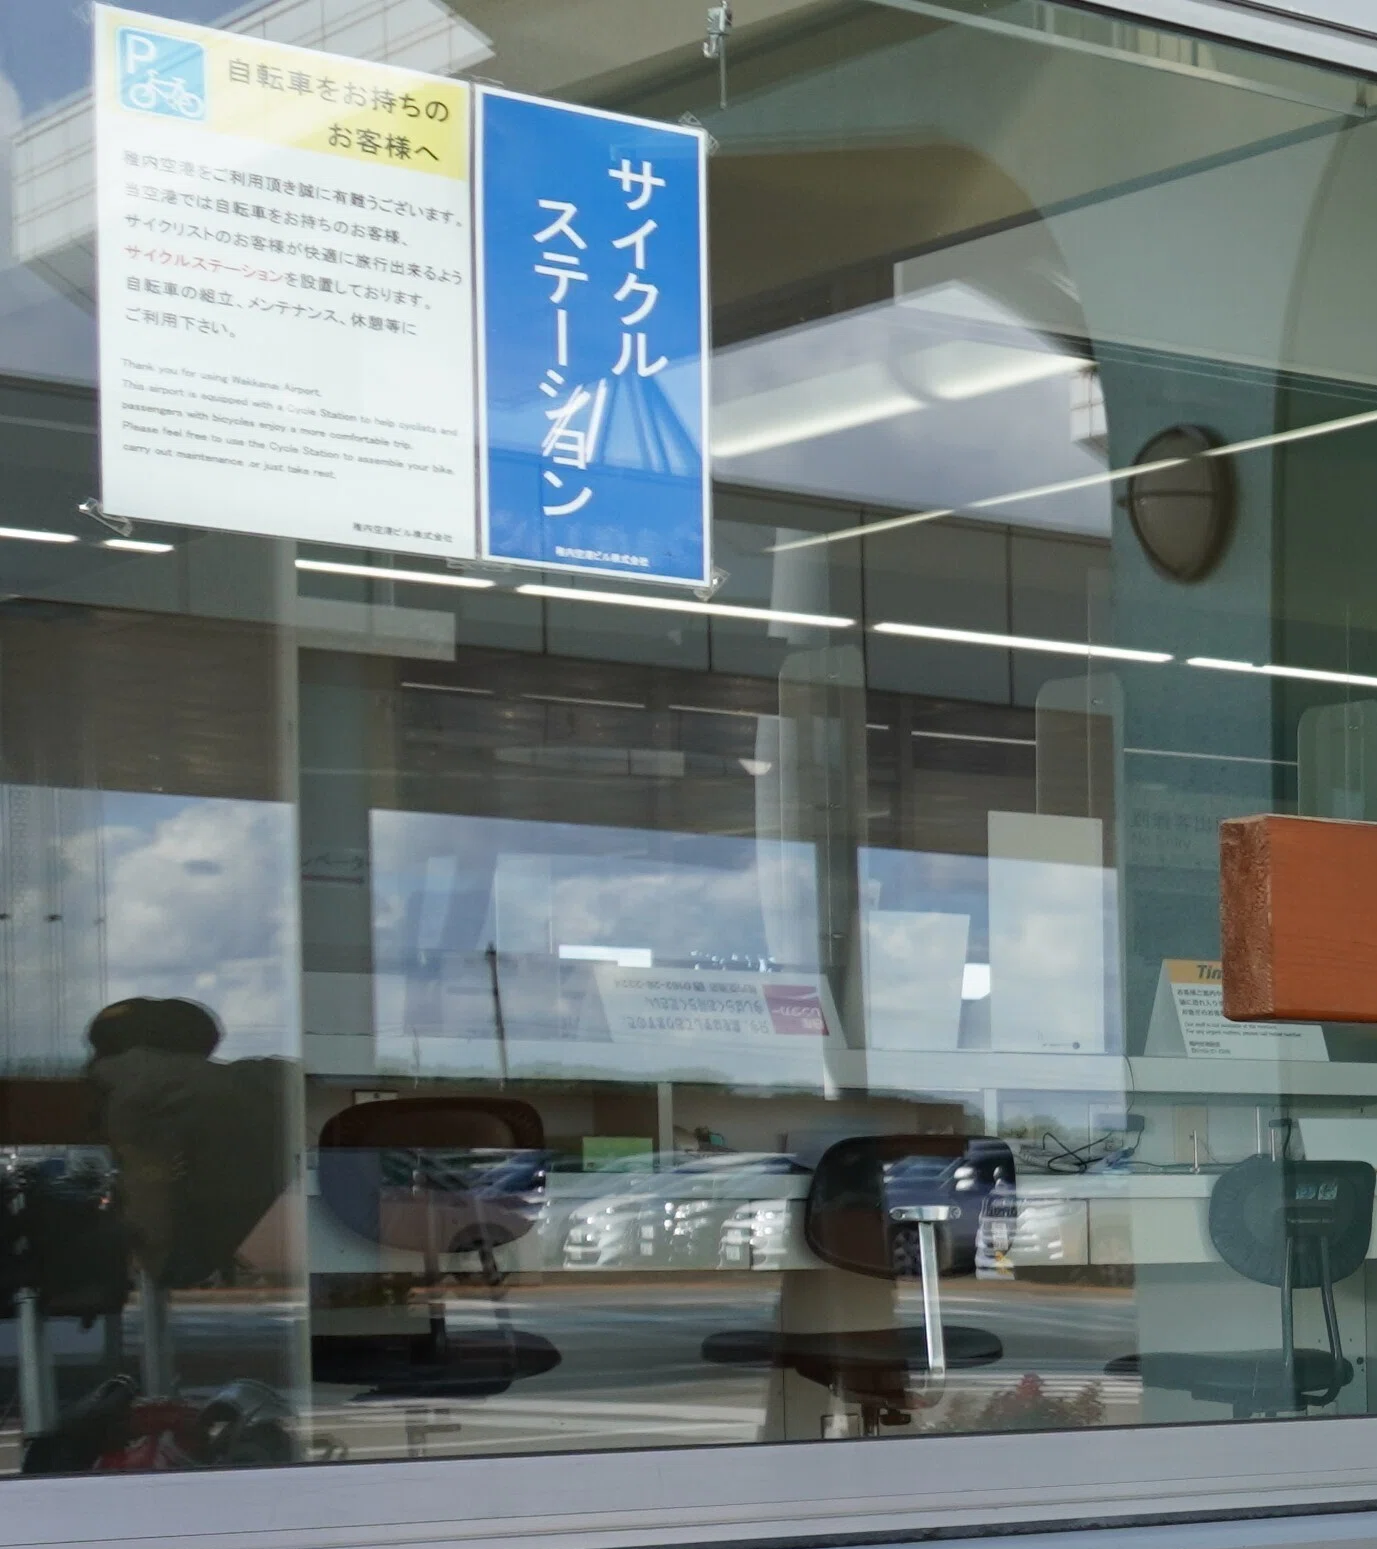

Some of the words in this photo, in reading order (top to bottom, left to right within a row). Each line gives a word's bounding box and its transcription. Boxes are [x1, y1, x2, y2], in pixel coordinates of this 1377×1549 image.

[229, 59, 449, 122] 自転車をお持ちの
[328, 123, 439, 161] お客様へ
[123, 150, 462, 228] 稚内空港をご利用頂き誠に有難うございます。
[608, 159, 669, 377] サイクル
[126, 307, 236, 338] ご利用下さい。
[533, 199, 592, 516] ステーション
